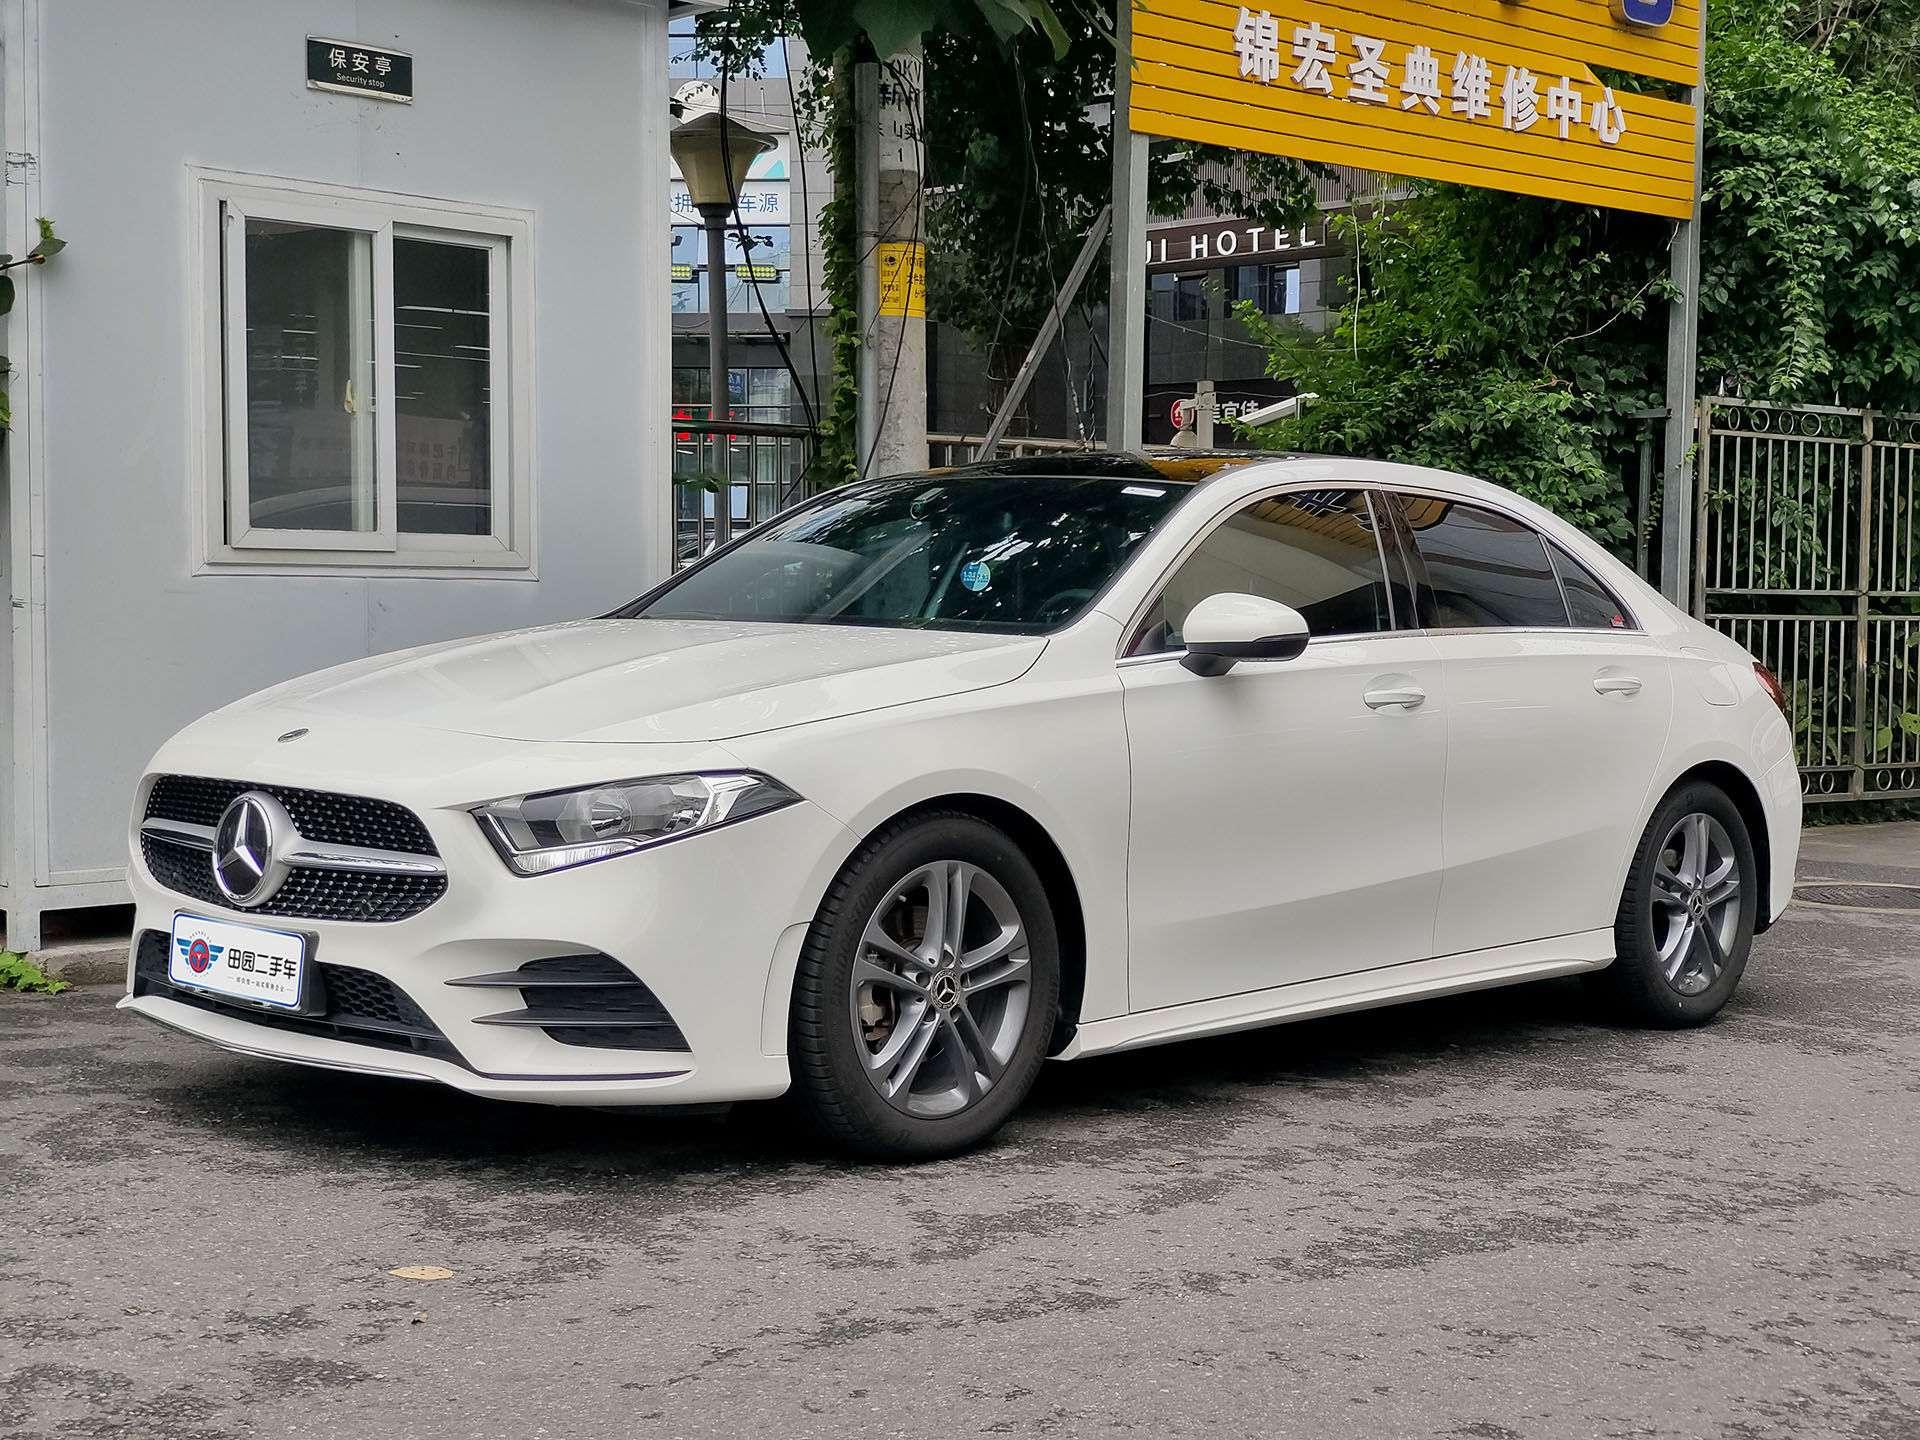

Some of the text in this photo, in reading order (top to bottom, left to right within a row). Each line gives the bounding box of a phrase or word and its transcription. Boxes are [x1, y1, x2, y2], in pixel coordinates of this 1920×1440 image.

[328, 47, 392, 76] 保安亭
[1232, 6, 1628, 145] 锦宏圣典维修中心
[336, 72, 385, 88] Security stop
[1190, 222, 1316, 259] HOTEL
[228, 948, 297, 979] 田园二手车
